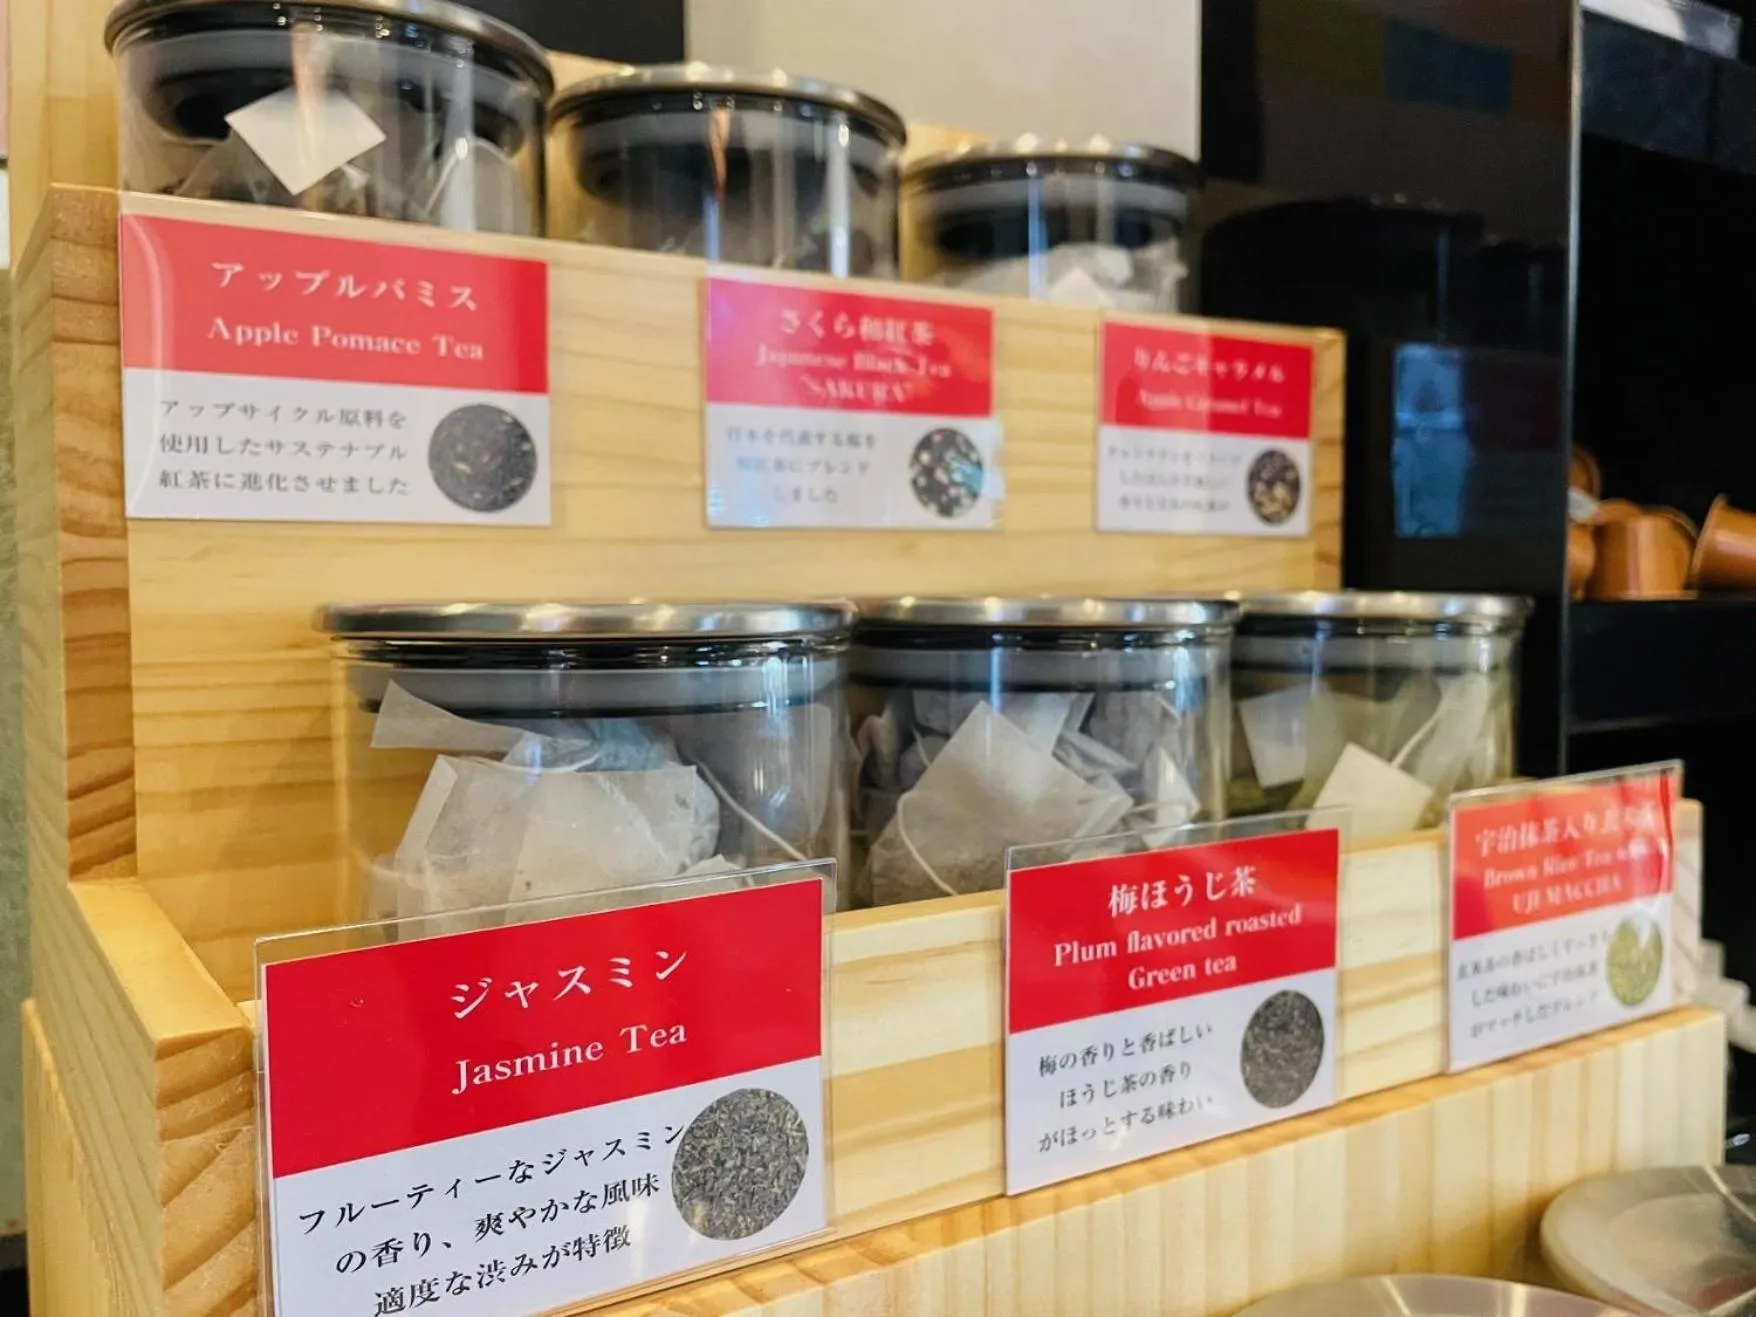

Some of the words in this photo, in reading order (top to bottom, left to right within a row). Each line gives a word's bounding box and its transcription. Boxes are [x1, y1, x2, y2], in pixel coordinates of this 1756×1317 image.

[207, 316, 299, 346] Apple
[312, 324, 421, 355] Pomace
[432, 334, 484, 360] Tea
[159, 399, 408, 431] アップサイクル原料を
[159, 433, 408, 461] 使用したサステナブル
[158, 469, 409, 496] 紅茶に進化させました
[1108, 865, 1257, 919] 梅ほうじ茶
[1053, 931, 1118, 967] Plum
[1127, 921, 1218, 955] flavored
[1225, 903, 1302, 938] roasted
[450, 946, 689, 1020] ジャスミン
[1128, 959, 1196, 991] Green
[1204, 954, 1238, 978] tea
[451, 1037, 606, 1096] Jasmine
[619, 1020, 689, 1054] Tea
[1039, 1023, 1213, 1077] 梅の香りと香ばしい
[1059, 1061, 1192, 1109] ほうじ茶の香り
[1038, 1094, 1214, 1153] がほっとする味わい
[298, 1124, 685, 1236] フルーティーなジャスミン
[335, 1172, 661, 1275] の香り、爽やかな風味
[373, 1223, 631, 1317] 適度な渋みが特徴
